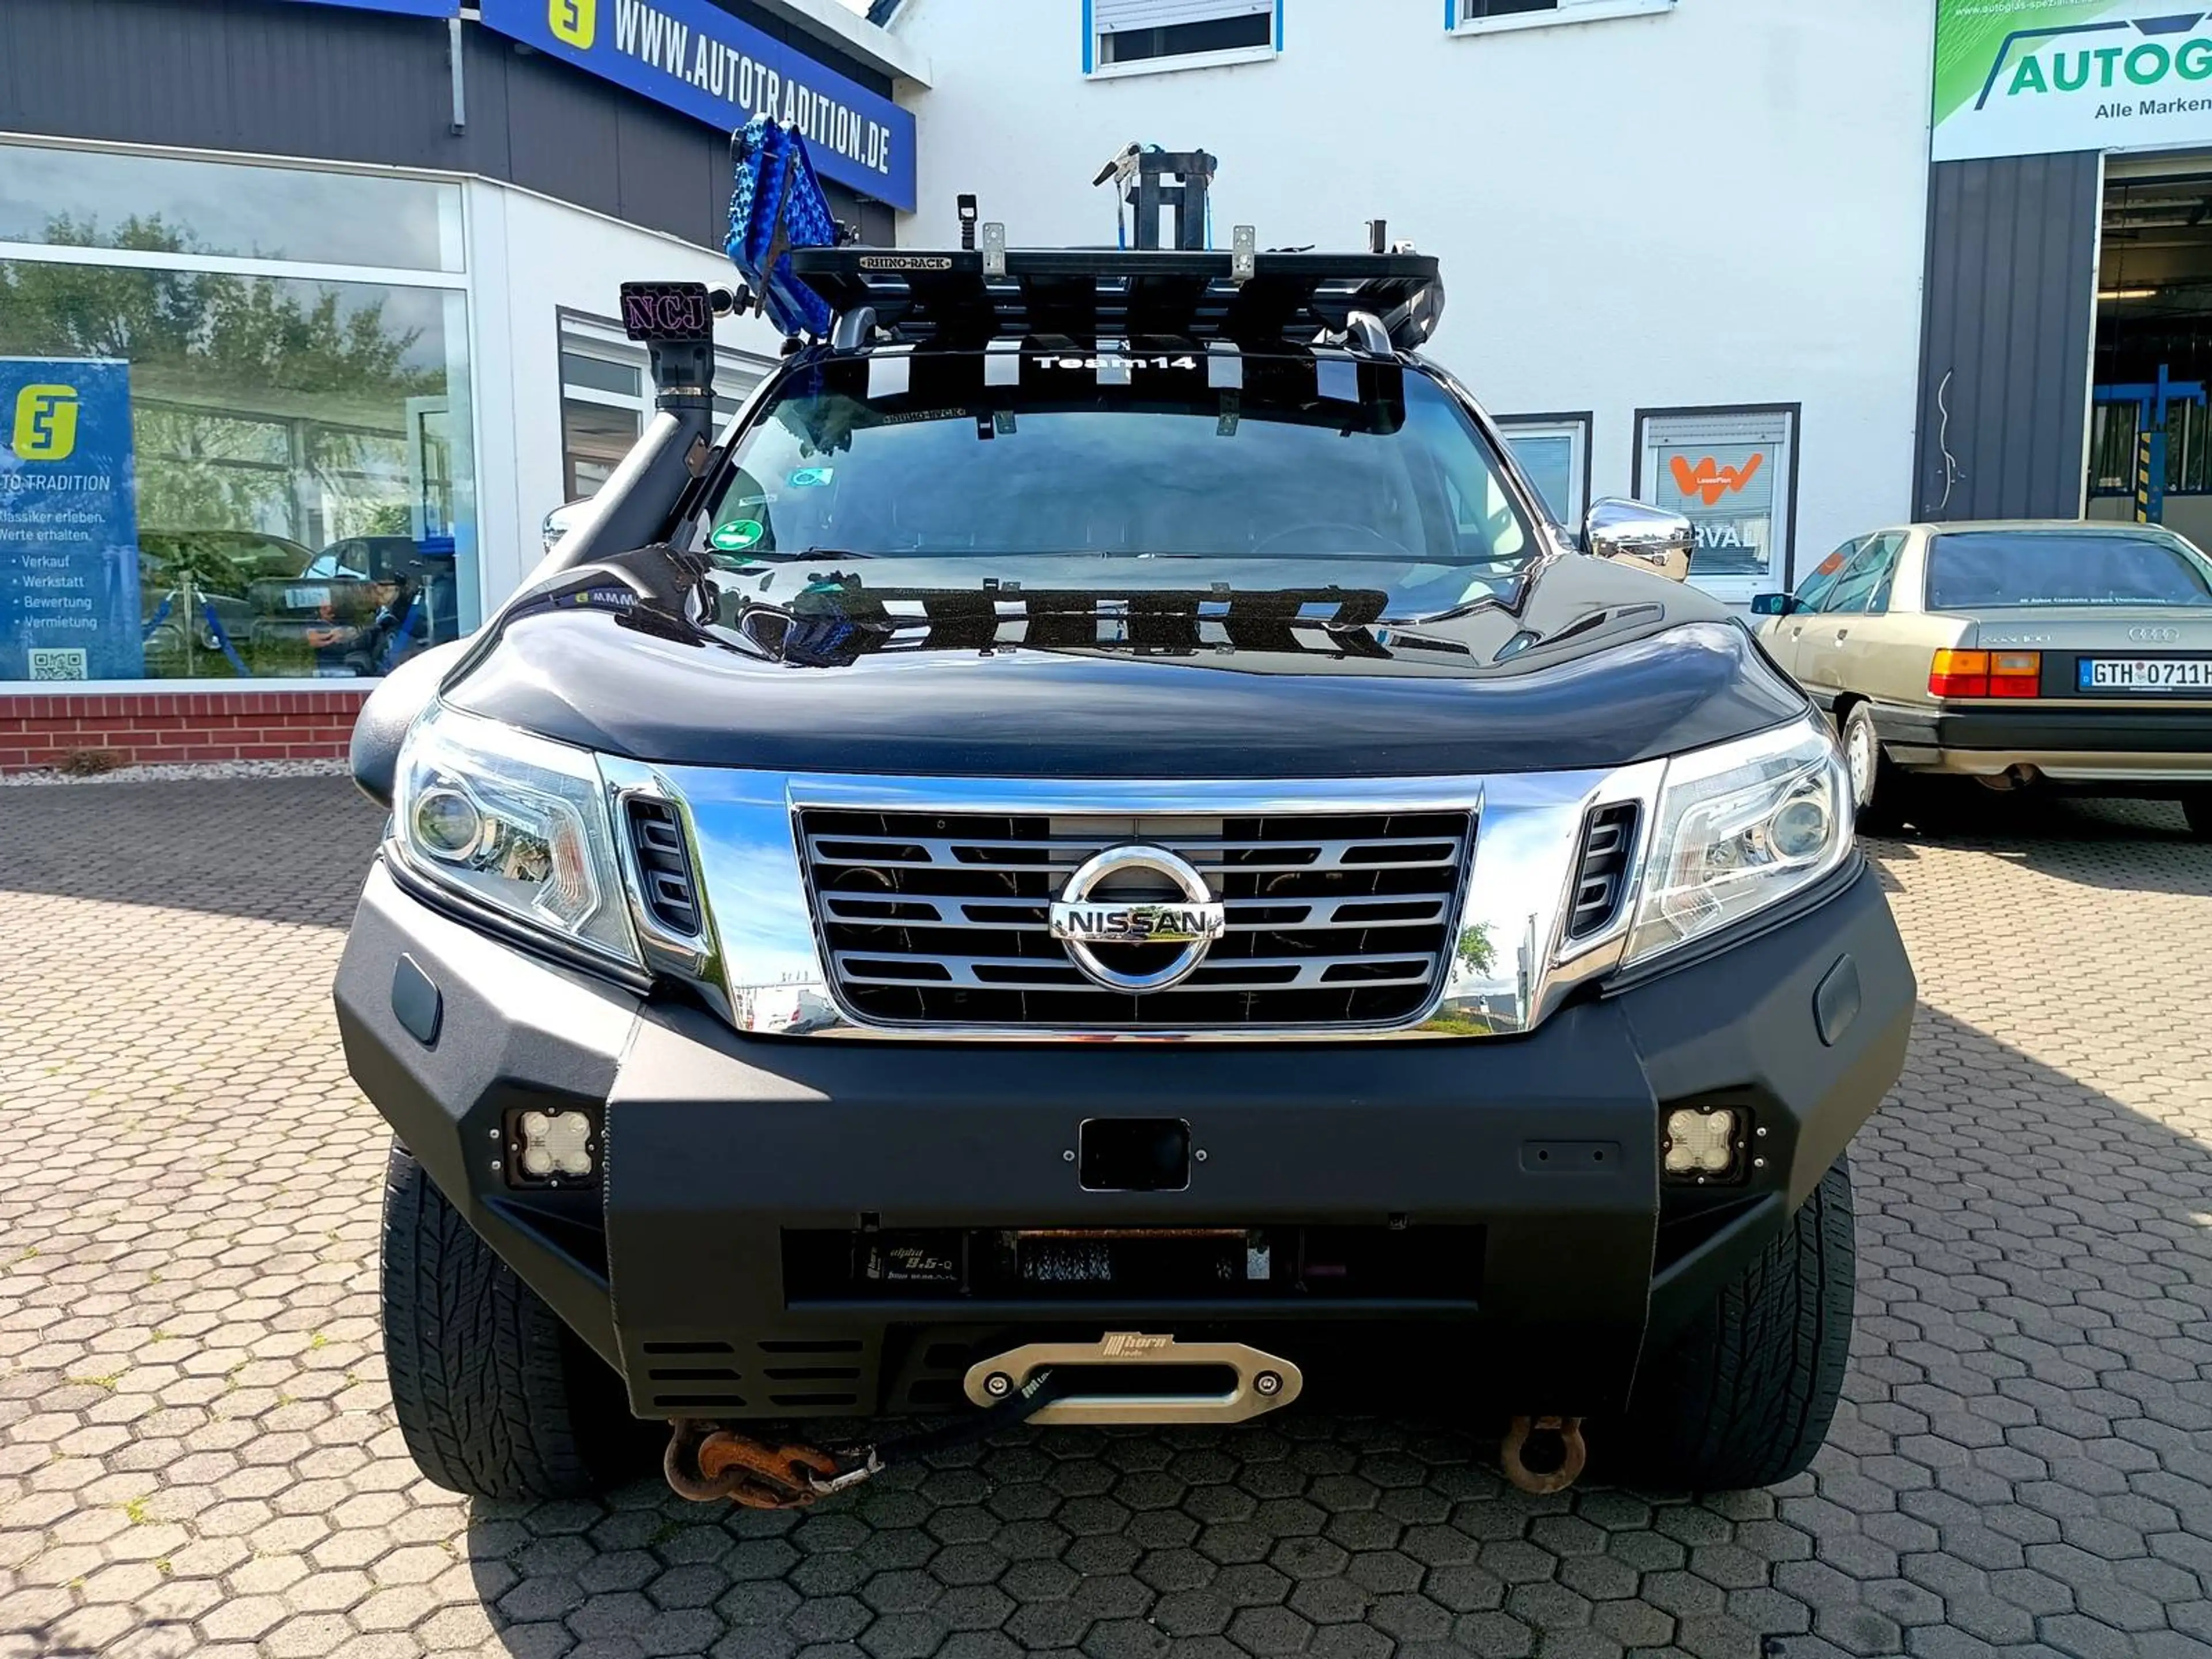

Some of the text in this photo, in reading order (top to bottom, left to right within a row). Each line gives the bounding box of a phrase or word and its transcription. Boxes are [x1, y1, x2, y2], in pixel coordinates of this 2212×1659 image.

[2008, 38, 2212, 96] AUTOG
[614, 0, 889, 174] WWW.AUTOTRADITION.DE
[2094, 97, 2212, 119] Alle Marken
[867, 257, 945, 268] RHINO-RACK
[626, 296, 704, 329] NCJ
[1033, 355, 1196, 369] Team14
[27, 475, 111, 491] TRADITION
[55, 510, 106, 523] erleben.
[37, 528, 92, 541] erhalten.
[22, 555, 70, 568] Verkauf
[22, 575, 85, 588] Werkstatt
[24, 596, 92, 611] Bewertung
[25, 615, 98, 631] Vermietung
[2094, 664, 2133, 683] GTH
[1069, 911, 1205, 933] NISSAN
